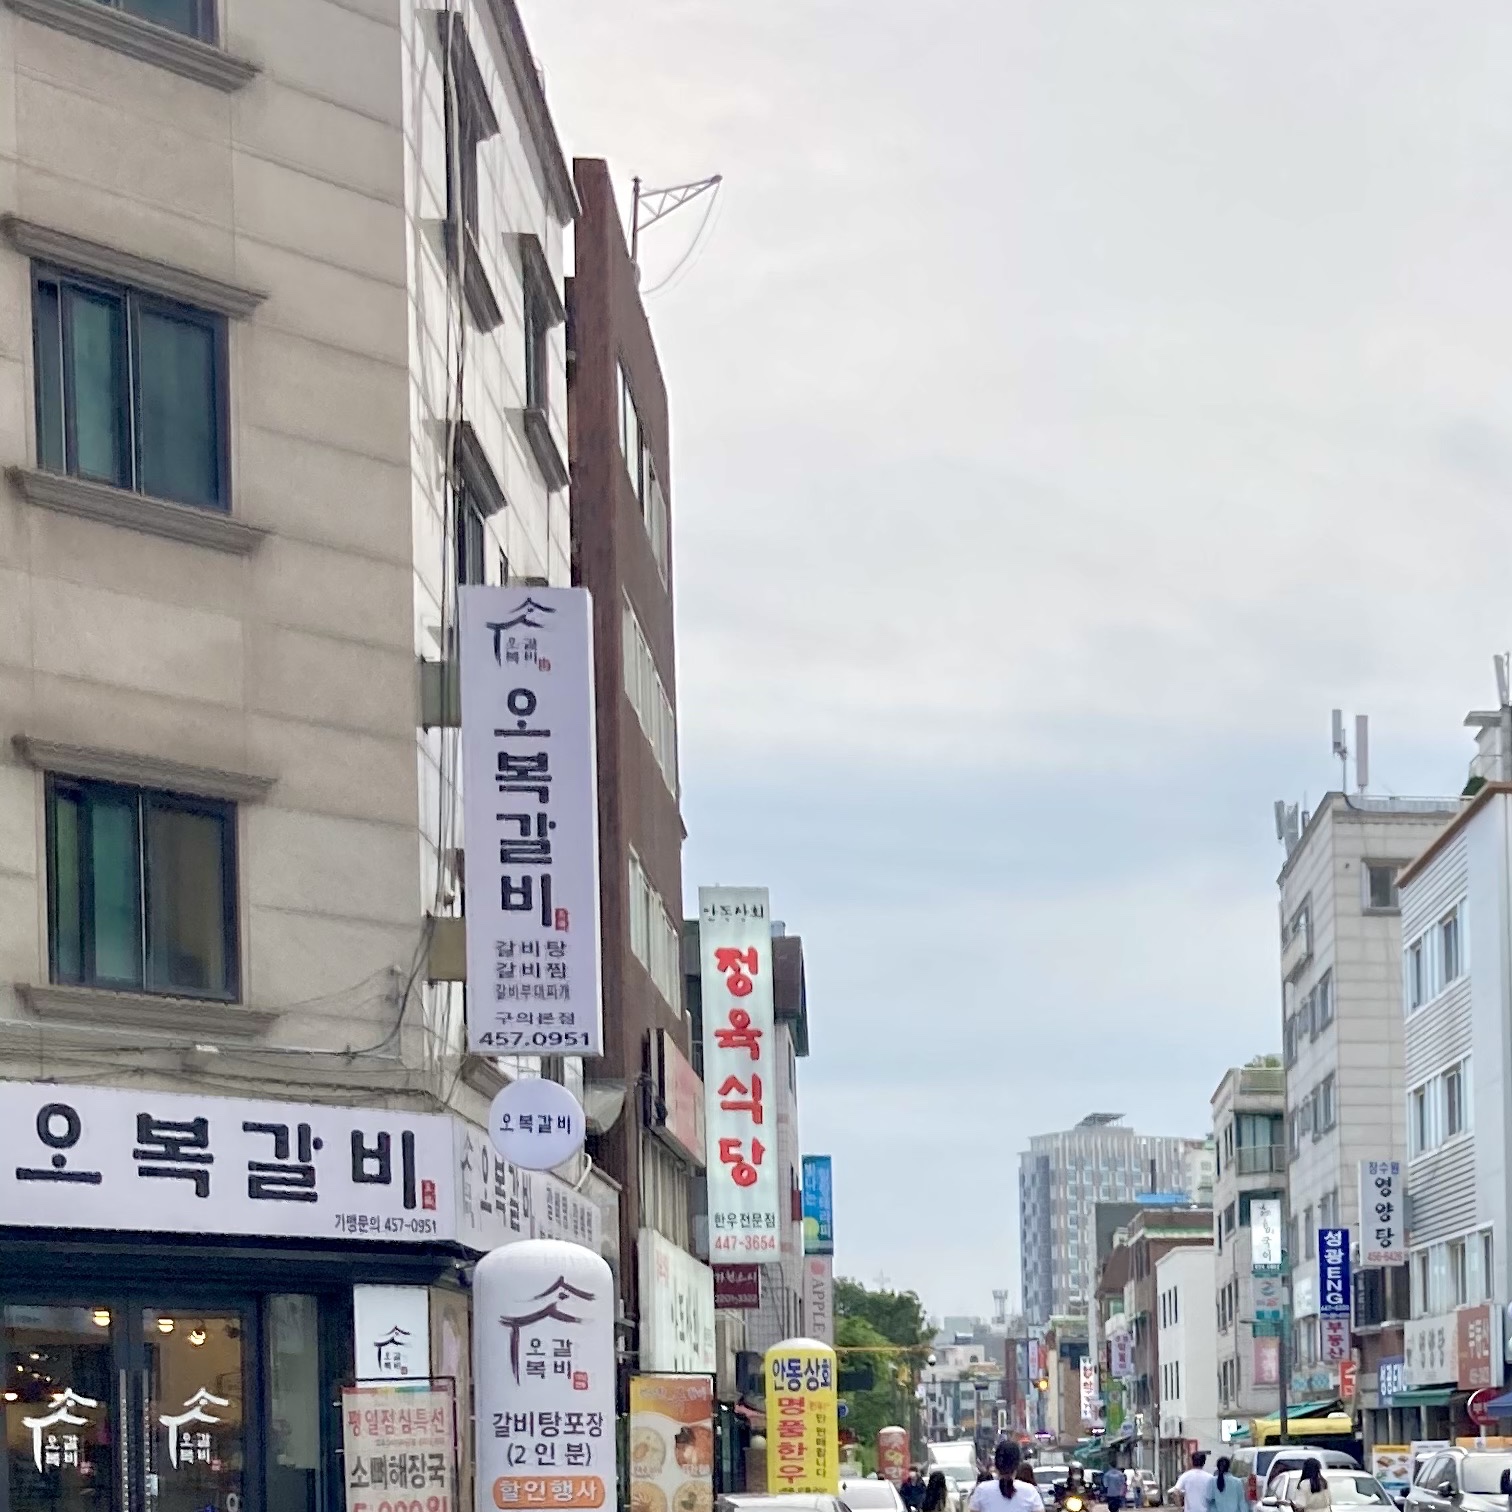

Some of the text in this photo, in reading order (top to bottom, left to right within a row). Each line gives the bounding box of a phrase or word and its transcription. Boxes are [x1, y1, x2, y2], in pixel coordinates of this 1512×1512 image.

[493, 686, 557, 928] 오복갈비
[496, 940, 567, 959] 갈비탕
[496, 962, 567, 980] 갈비찜
[478, 1031, 590, 1047] 457.0951
[713, 945, 767, 1188] 정육식당
[499, 1113, 572, 1135] 오복갈비
[14, 1102, 418, 1211] 오복갈비
[714, 1212, 777, 1229] 한우전문점
[1374, 1176, 1395, 1249] 영양탕
[714, 1235, 776, 1251] 447-3654
[772, 1357, 833, 1392] 안동상회
[347, 1407, 446, 1438] 평일점심특선
[492, 1411, 604, 1438] 갈비탕포장
[499, 1480, 598, 1502] 할인행사
